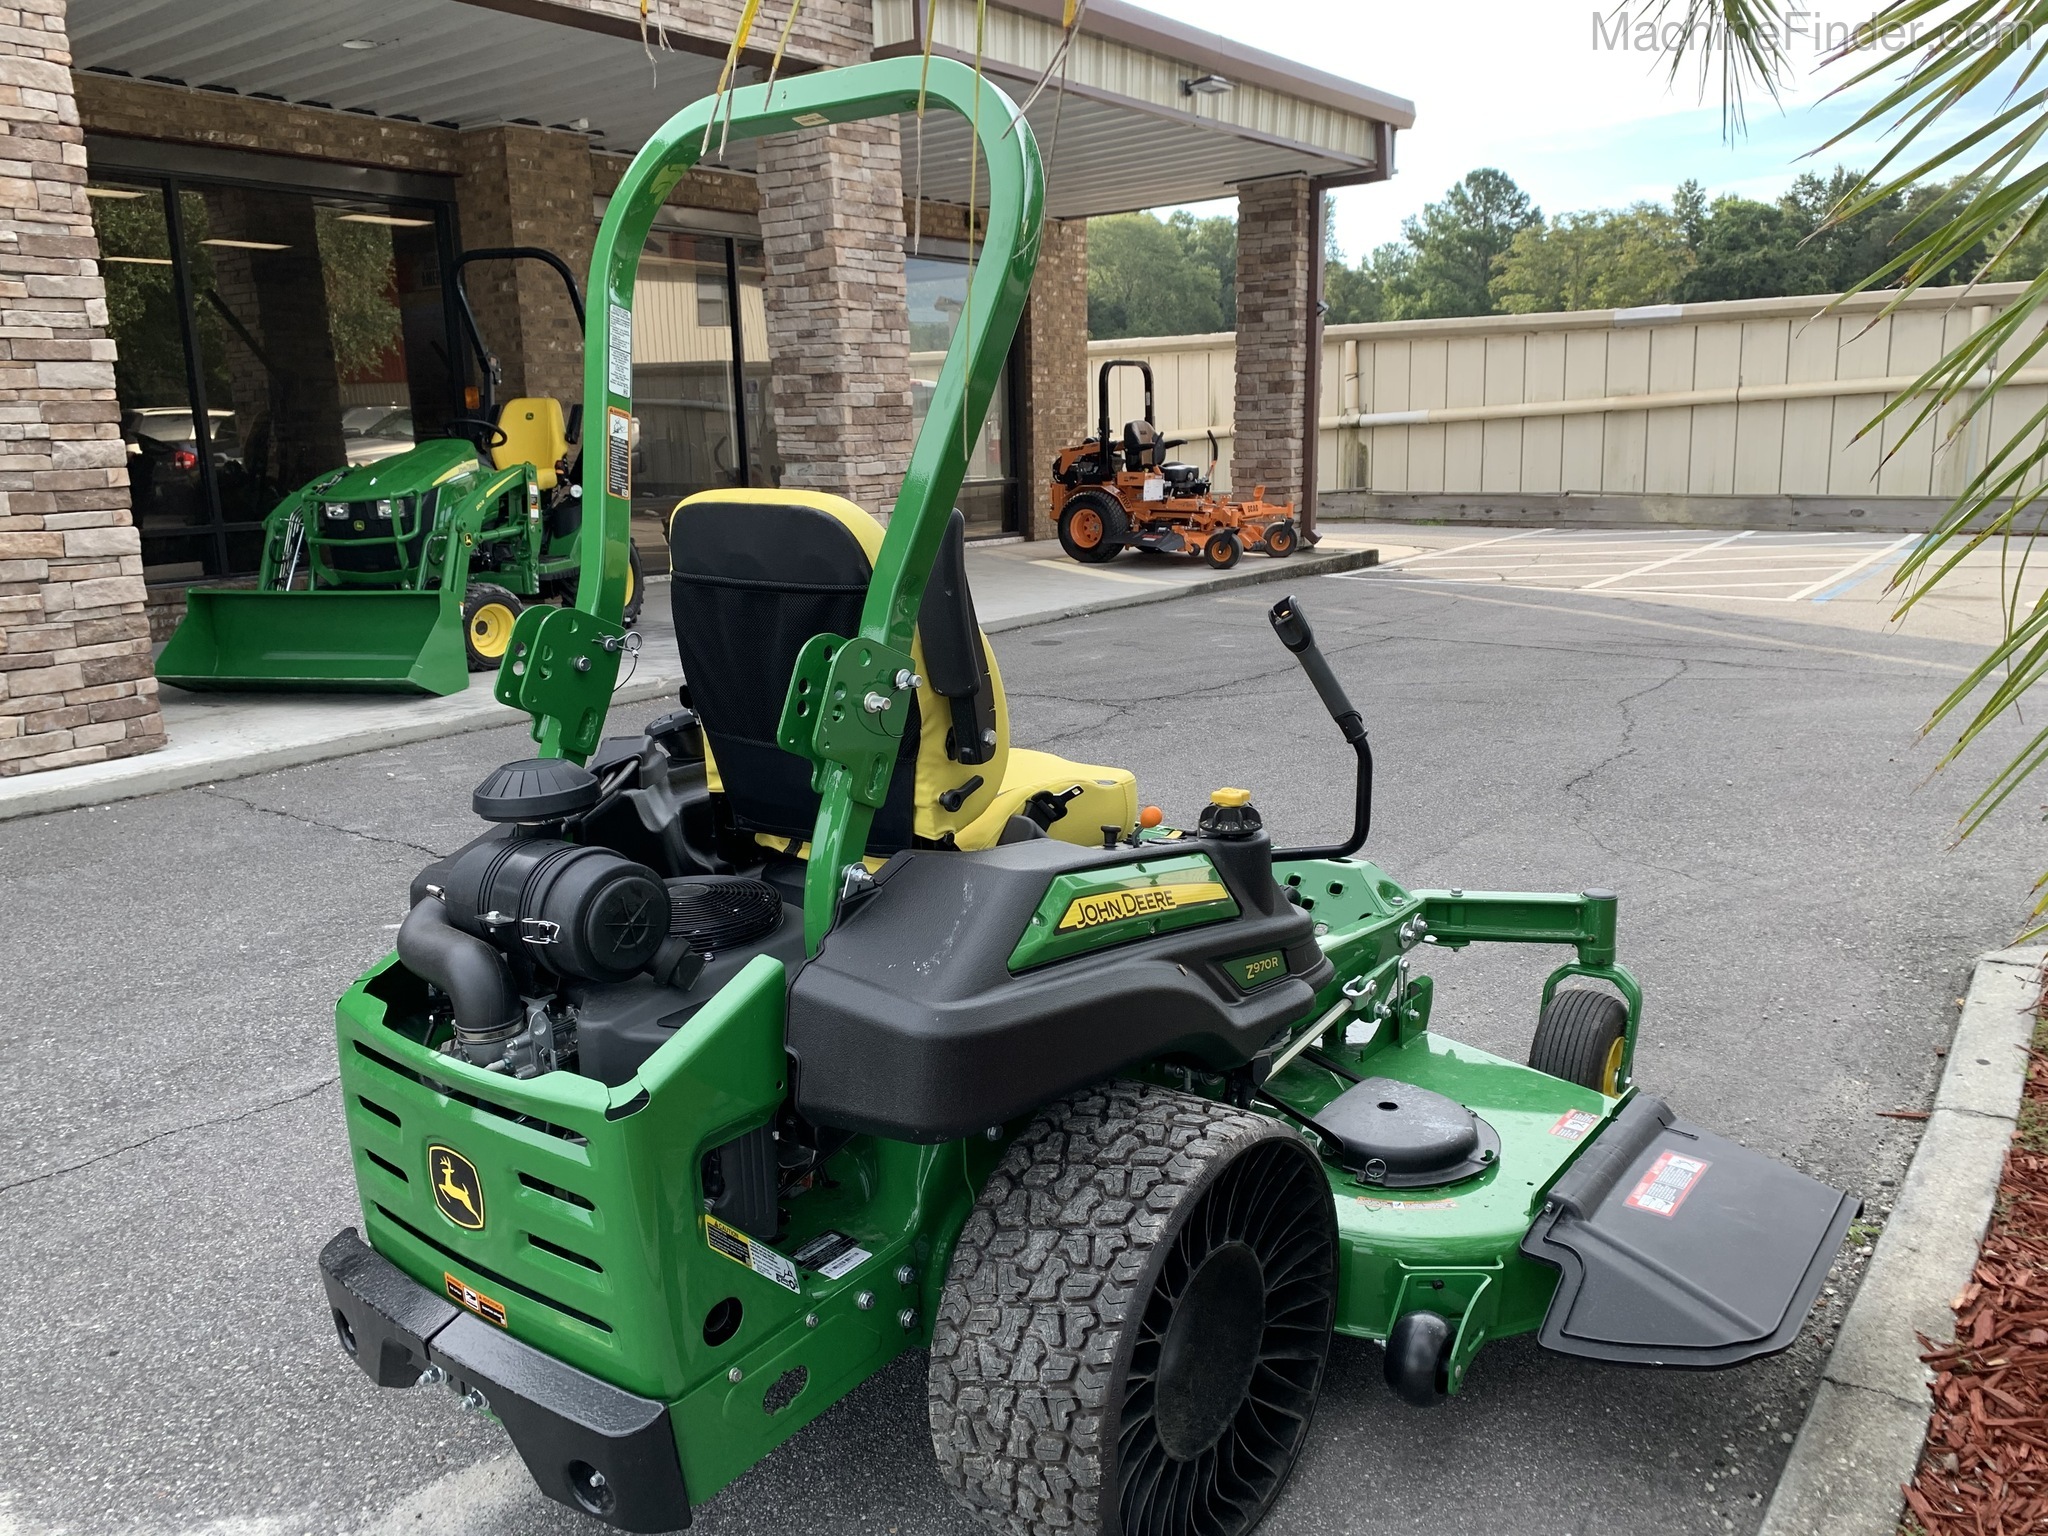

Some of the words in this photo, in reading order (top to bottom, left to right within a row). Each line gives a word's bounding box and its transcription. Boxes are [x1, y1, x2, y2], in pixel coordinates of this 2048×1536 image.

[1076, 897, 1123, 925] JOHN
[1123, 890, 1176, 916] DEERE
[1245, 956, 1279, 980] Z970R
[719, 1223, 740, 1239] CAUTION
